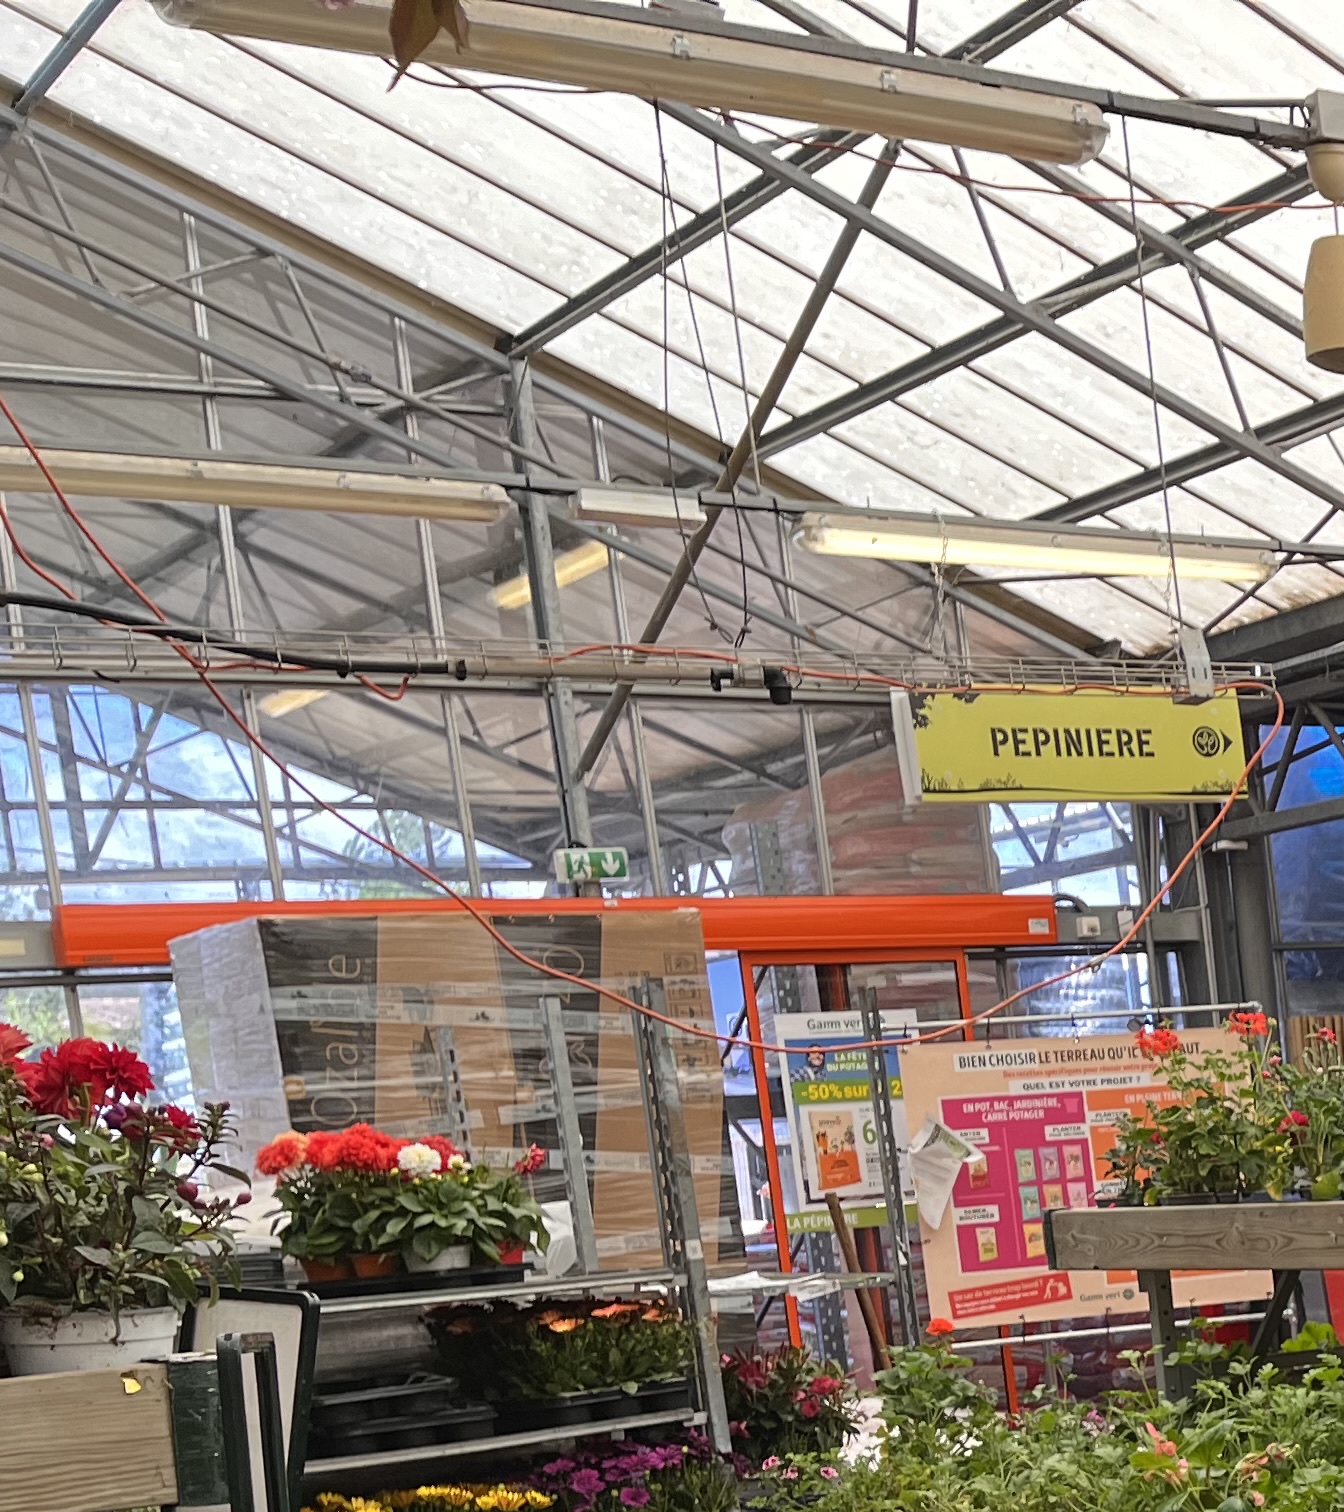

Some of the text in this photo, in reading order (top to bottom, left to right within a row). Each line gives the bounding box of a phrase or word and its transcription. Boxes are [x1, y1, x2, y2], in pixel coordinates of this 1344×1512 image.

[990, 726, 1156, 758] PEPINIERE
[806, 1018, 862, 1030] Gamm ver
[834, 1052, 847, 1062] LA
[958, 1054, 987, 1069] BIEN
[988, 1051, 1037, 1068] CHOISIR
[1038, 1051, 1052, 1064] LE
[1053, 1047, 1105, 1063] TERREAU
[826, 1061, 868, 1073] DU POTAG
[801, 1083, 843, 1101] -50%
[843, 1084, 869, 1098] sur
[1022, 1082, 1043, 1092] QUEL
[1100, 1076, 1134, 1086] PROJET
[862, 1119, 877, 1145] 6
